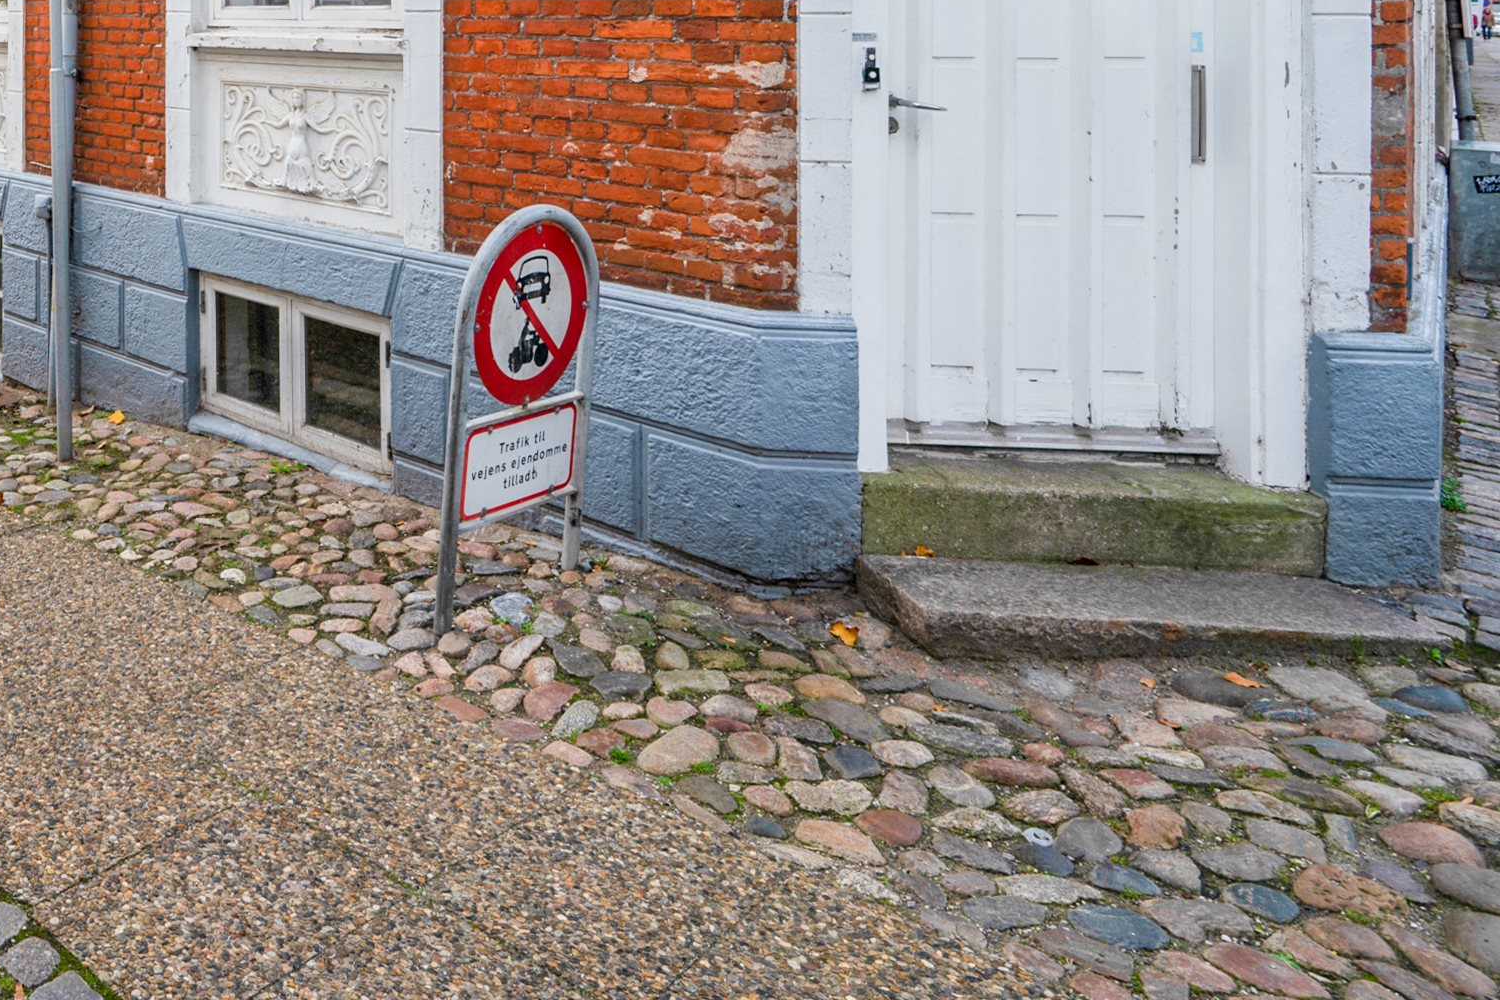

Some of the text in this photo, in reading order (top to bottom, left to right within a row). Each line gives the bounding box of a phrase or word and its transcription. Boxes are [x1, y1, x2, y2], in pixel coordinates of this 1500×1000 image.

[499, 430, 546, 454] Trafik til
[471, 442, 568, 481] vejens ejendomme
[503, 468, 537, 489] tilladt
